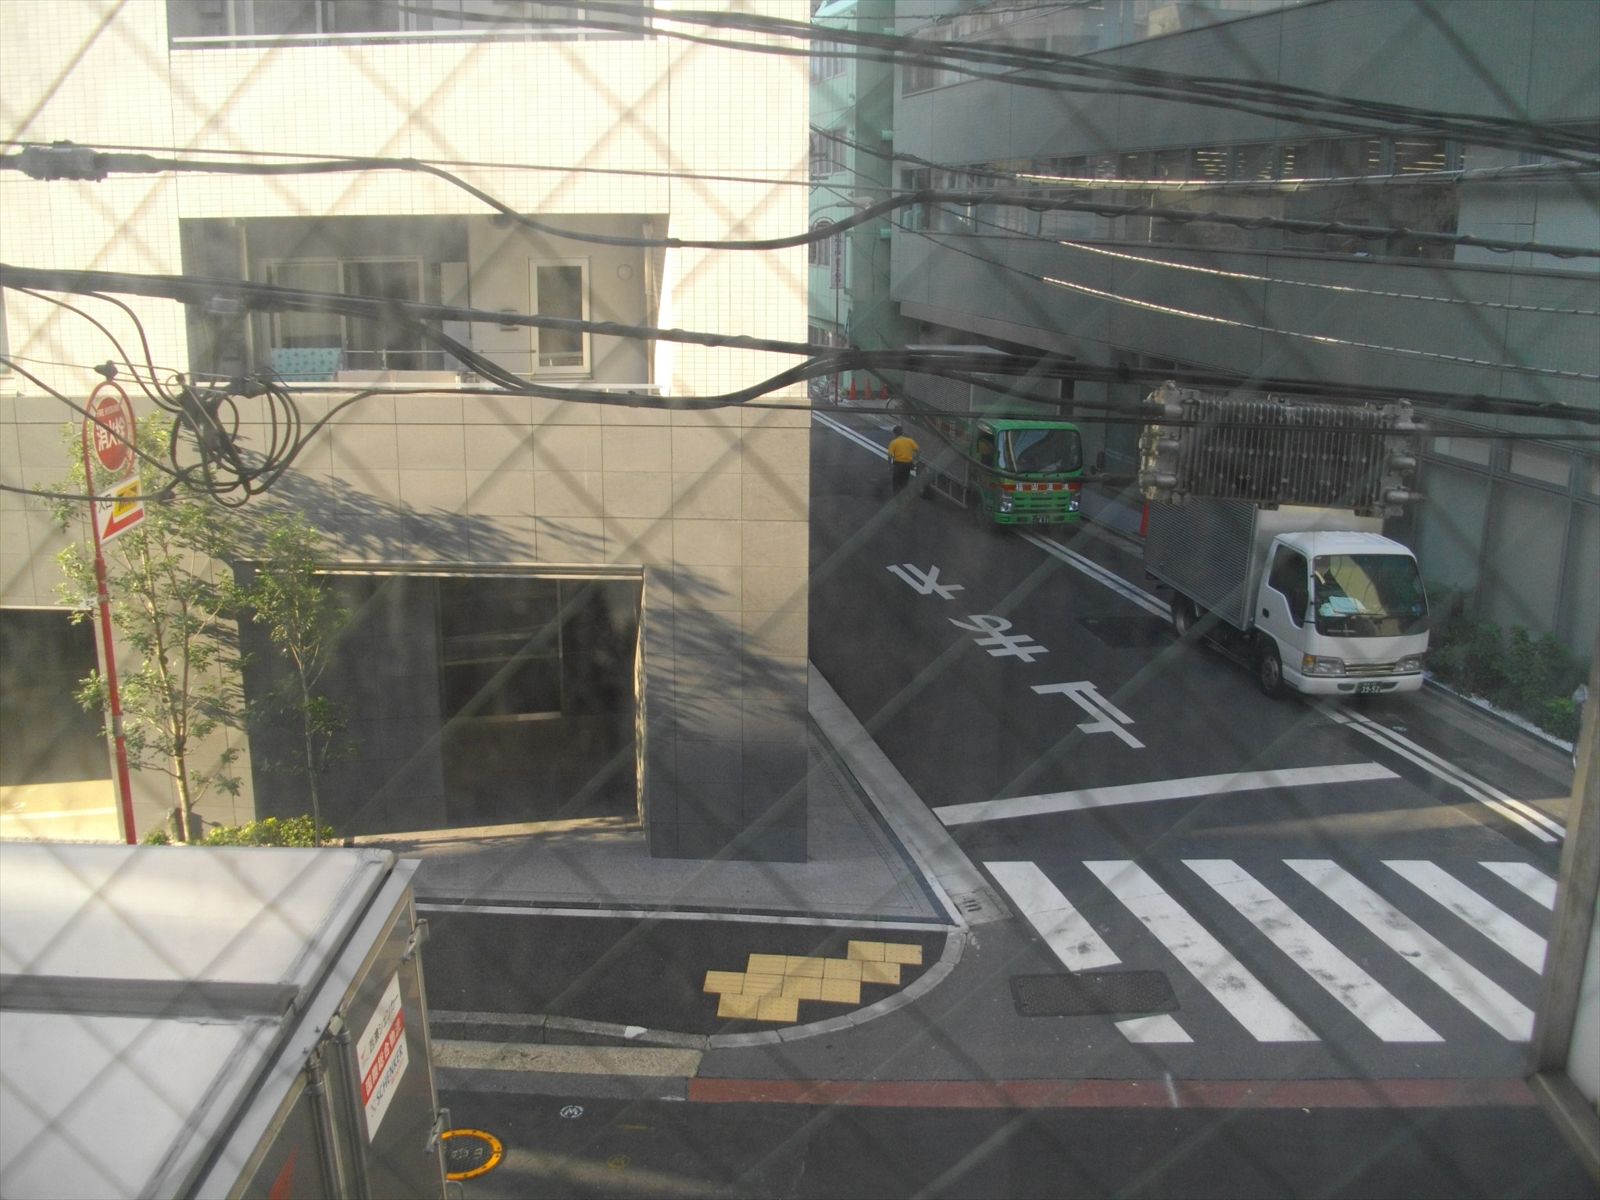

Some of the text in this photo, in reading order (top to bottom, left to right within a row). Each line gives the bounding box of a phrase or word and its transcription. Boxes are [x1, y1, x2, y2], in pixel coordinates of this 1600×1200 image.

[96, 417, 126, 451] 消火栓
[886, 564, 1146, 748] 止まれ
[376, 1044, 404, 1102] SCHENKER
